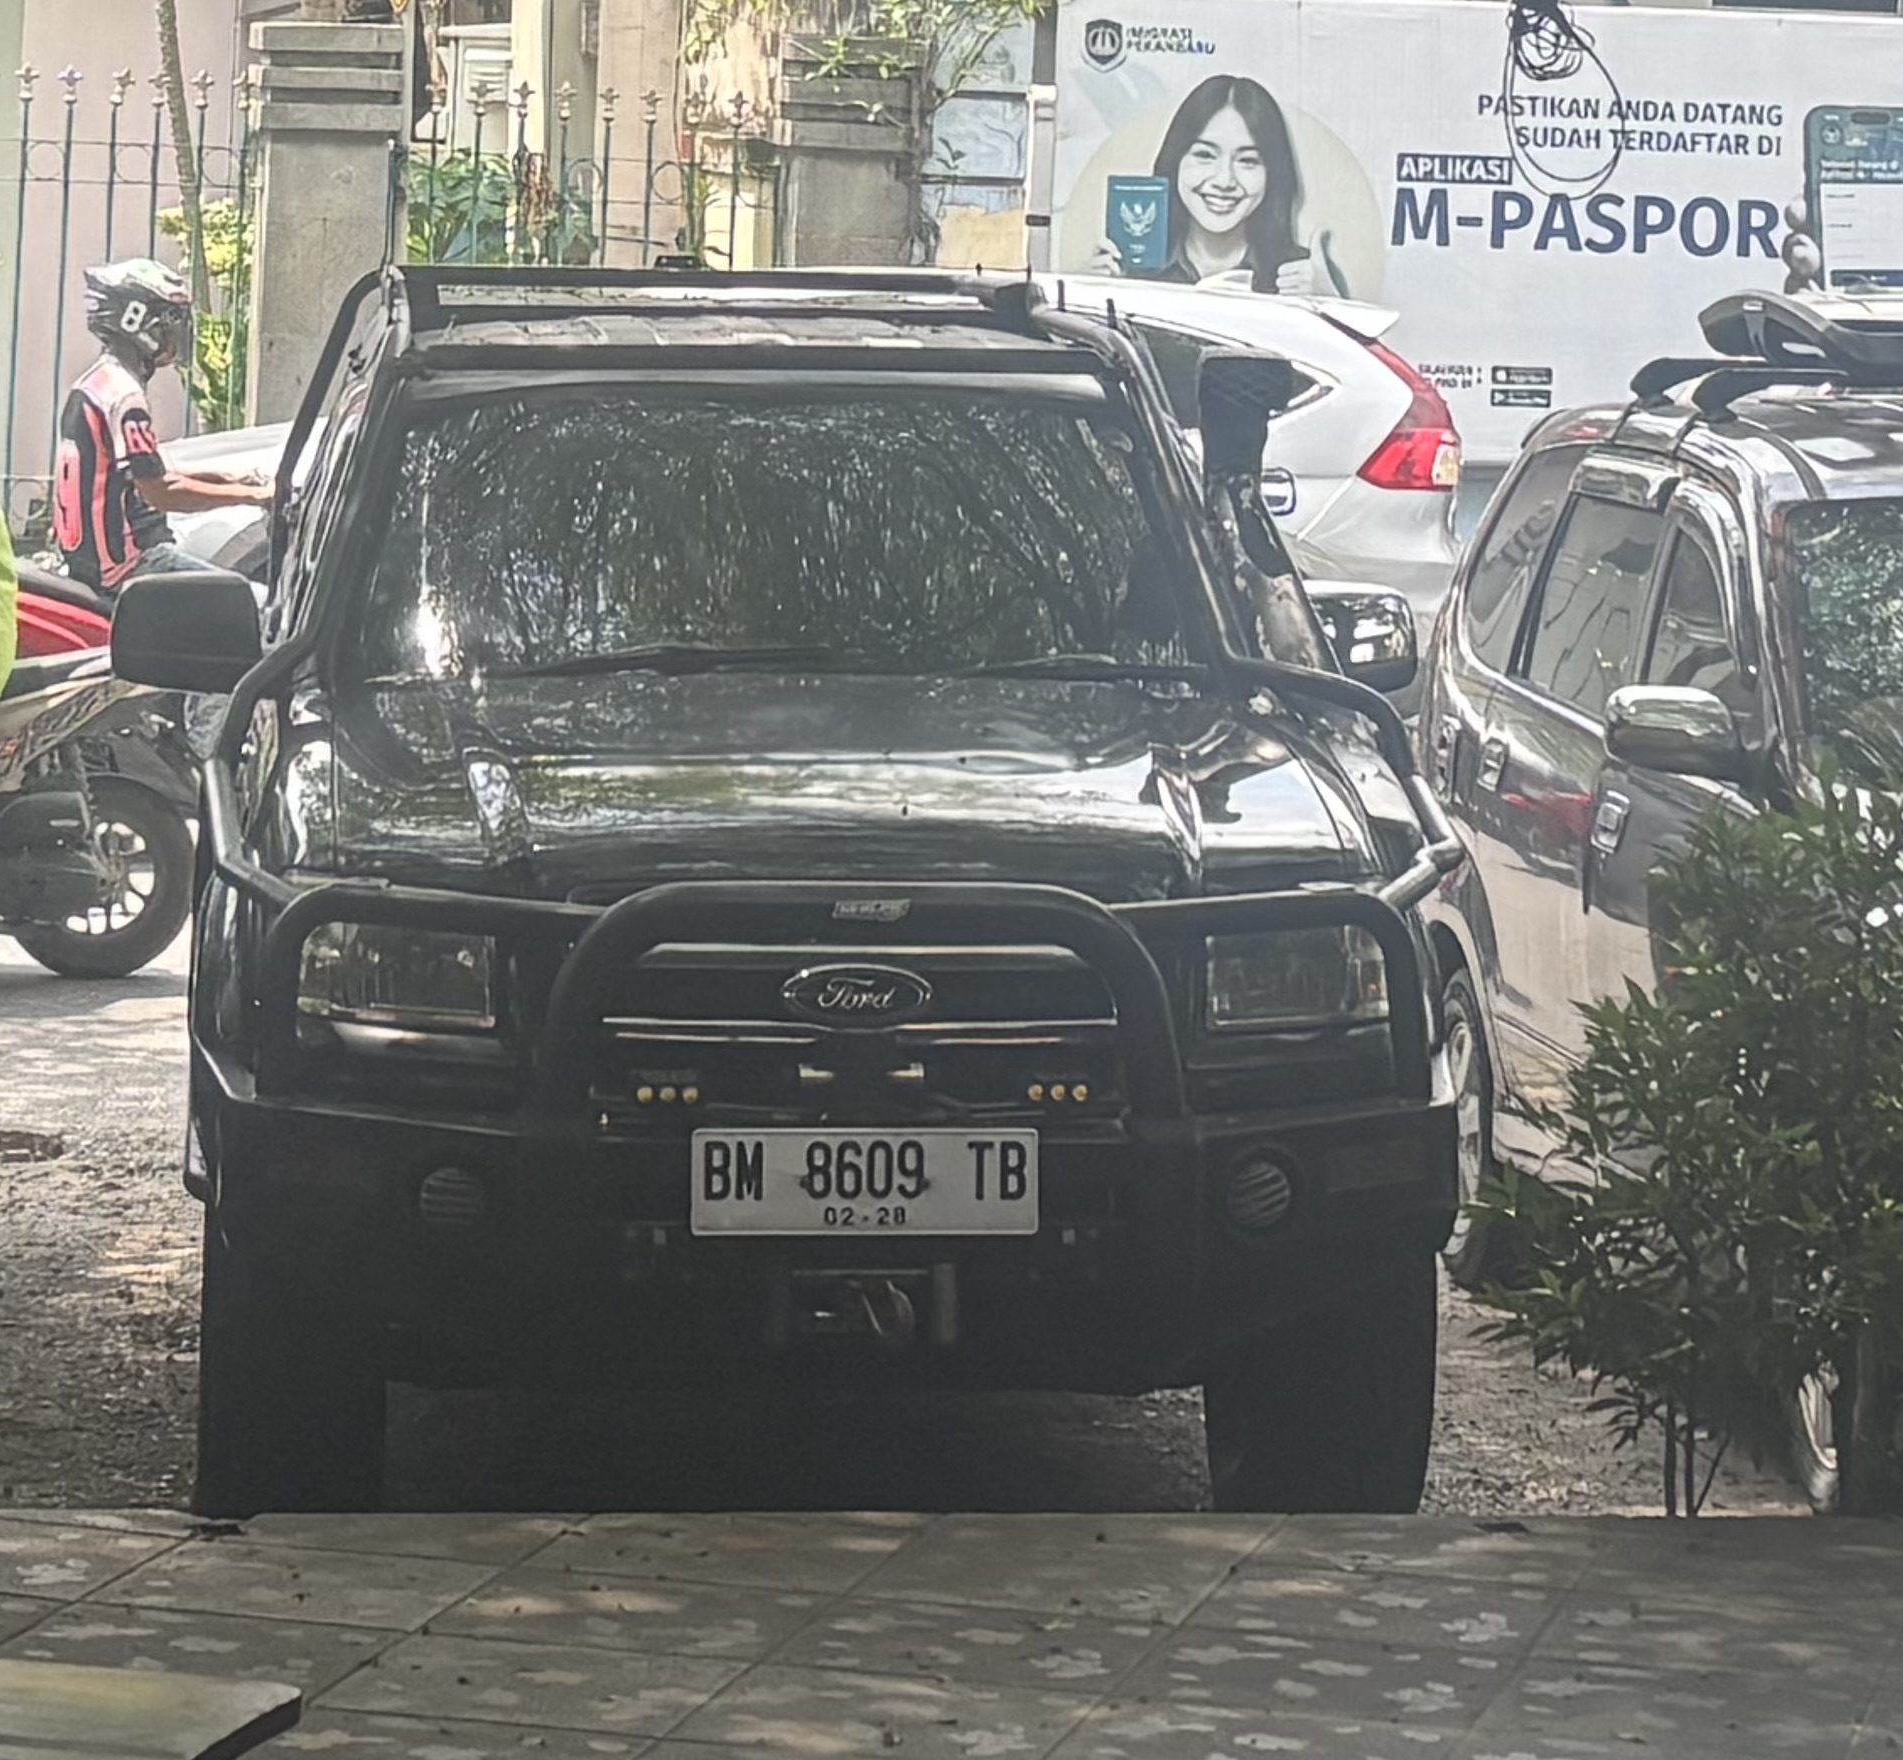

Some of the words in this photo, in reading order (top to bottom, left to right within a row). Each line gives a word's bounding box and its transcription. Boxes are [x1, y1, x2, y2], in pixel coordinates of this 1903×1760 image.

[1478, 94, 1600, 120] PASTIKAN
[1607, 99, 1677, 123] ANDA
[1683, 103, 1783, 127] DATANG
[1515, 125, 1601, 150] SUDAH
[1609, 128, 1751, 156] TERDAFTAR
[1757, 135, 1782, 157] DI
[1399, 156, 1510, 182] APLIKASI
[1391, 187, 1780, 259] M-PASPOR
[817, 976, 897, 1009] Ford
[703, 1140, 765, 1201] BM
[804, 1140, 926, 1201] 8609
[967, 1140, 1028, 1201] TB
